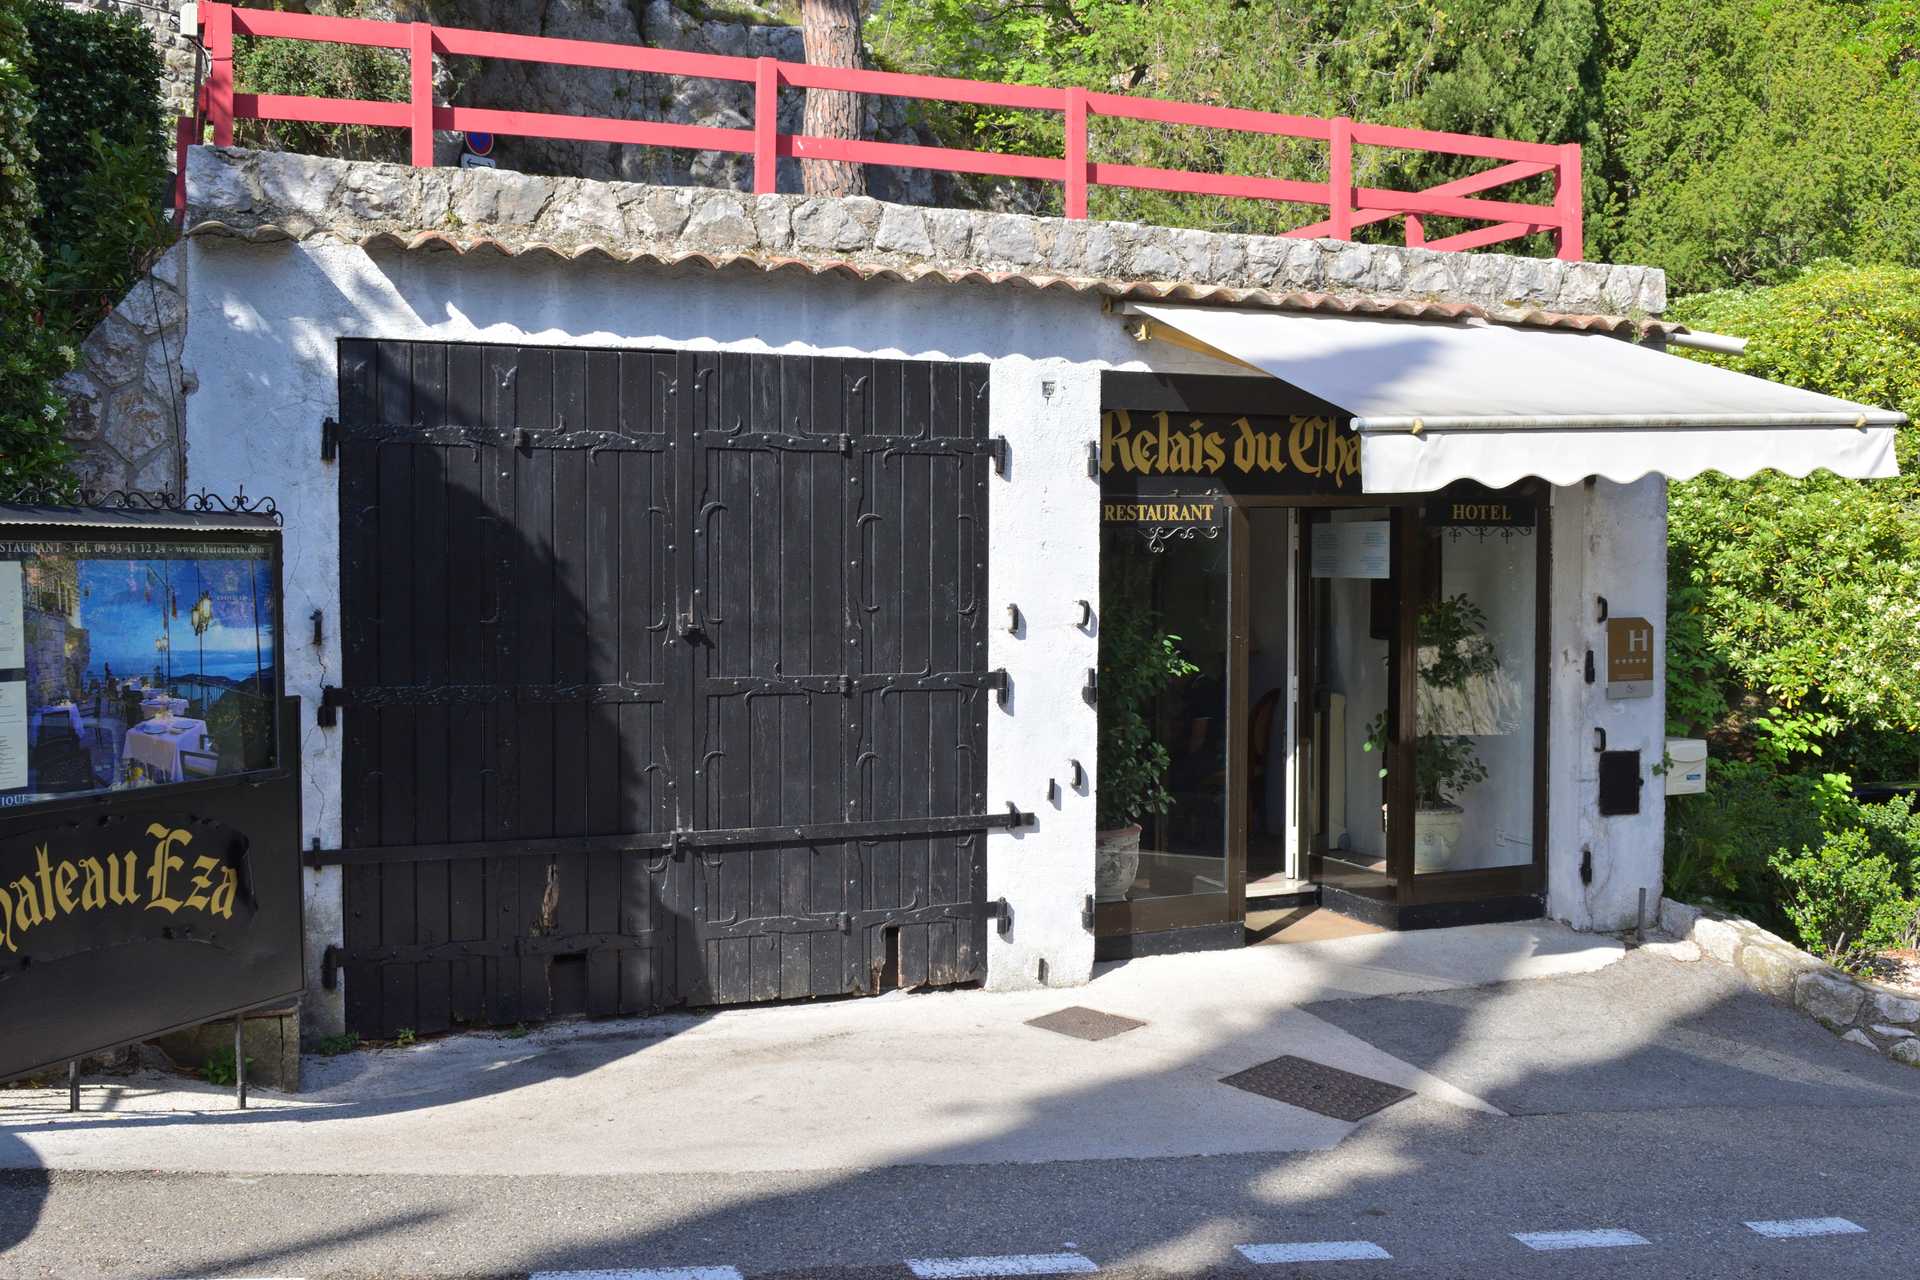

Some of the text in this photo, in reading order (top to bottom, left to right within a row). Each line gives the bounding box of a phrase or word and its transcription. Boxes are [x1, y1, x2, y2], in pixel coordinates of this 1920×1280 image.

[1100, 409, 1226, 475] Relais
[1232, 415, 1287, 475] du
[1104, 504, 1214, 522] RESTAURANT
[1452, 504, 1512, 521] HOTEL
[110, 543, 122, 554] 93
[141, 543, 152, 553] 12
[1629, 629, 1648, 652] H
[144, 822, 239, 920] Eza
